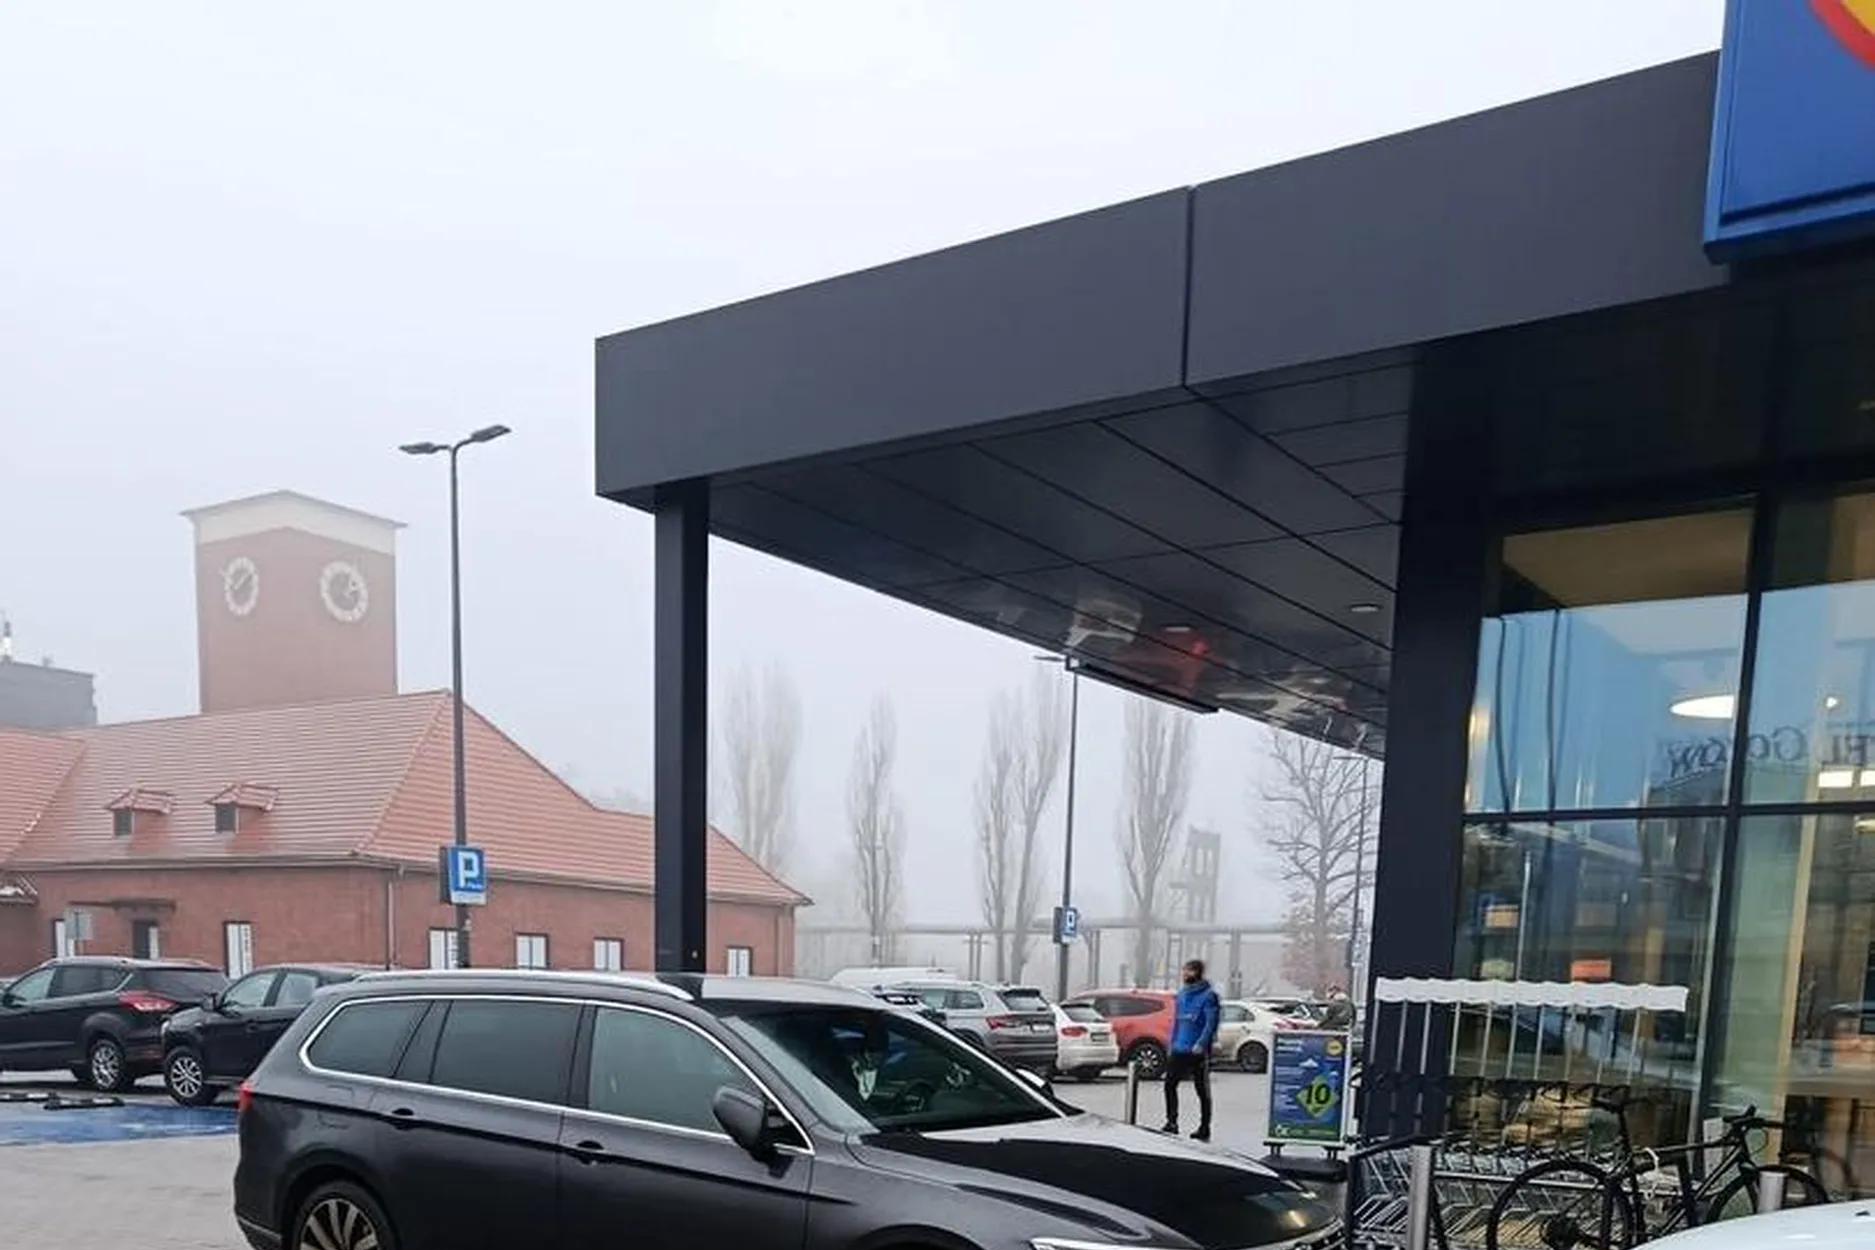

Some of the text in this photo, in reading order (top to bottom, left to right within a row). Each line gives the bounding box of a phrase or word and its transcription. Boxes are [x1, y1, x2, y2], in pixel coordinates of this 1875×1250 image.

[458, 851, 479, 888] P
[1065, 911, 1075, 933] P
[1306, 1083, 1331, 1105] 10
